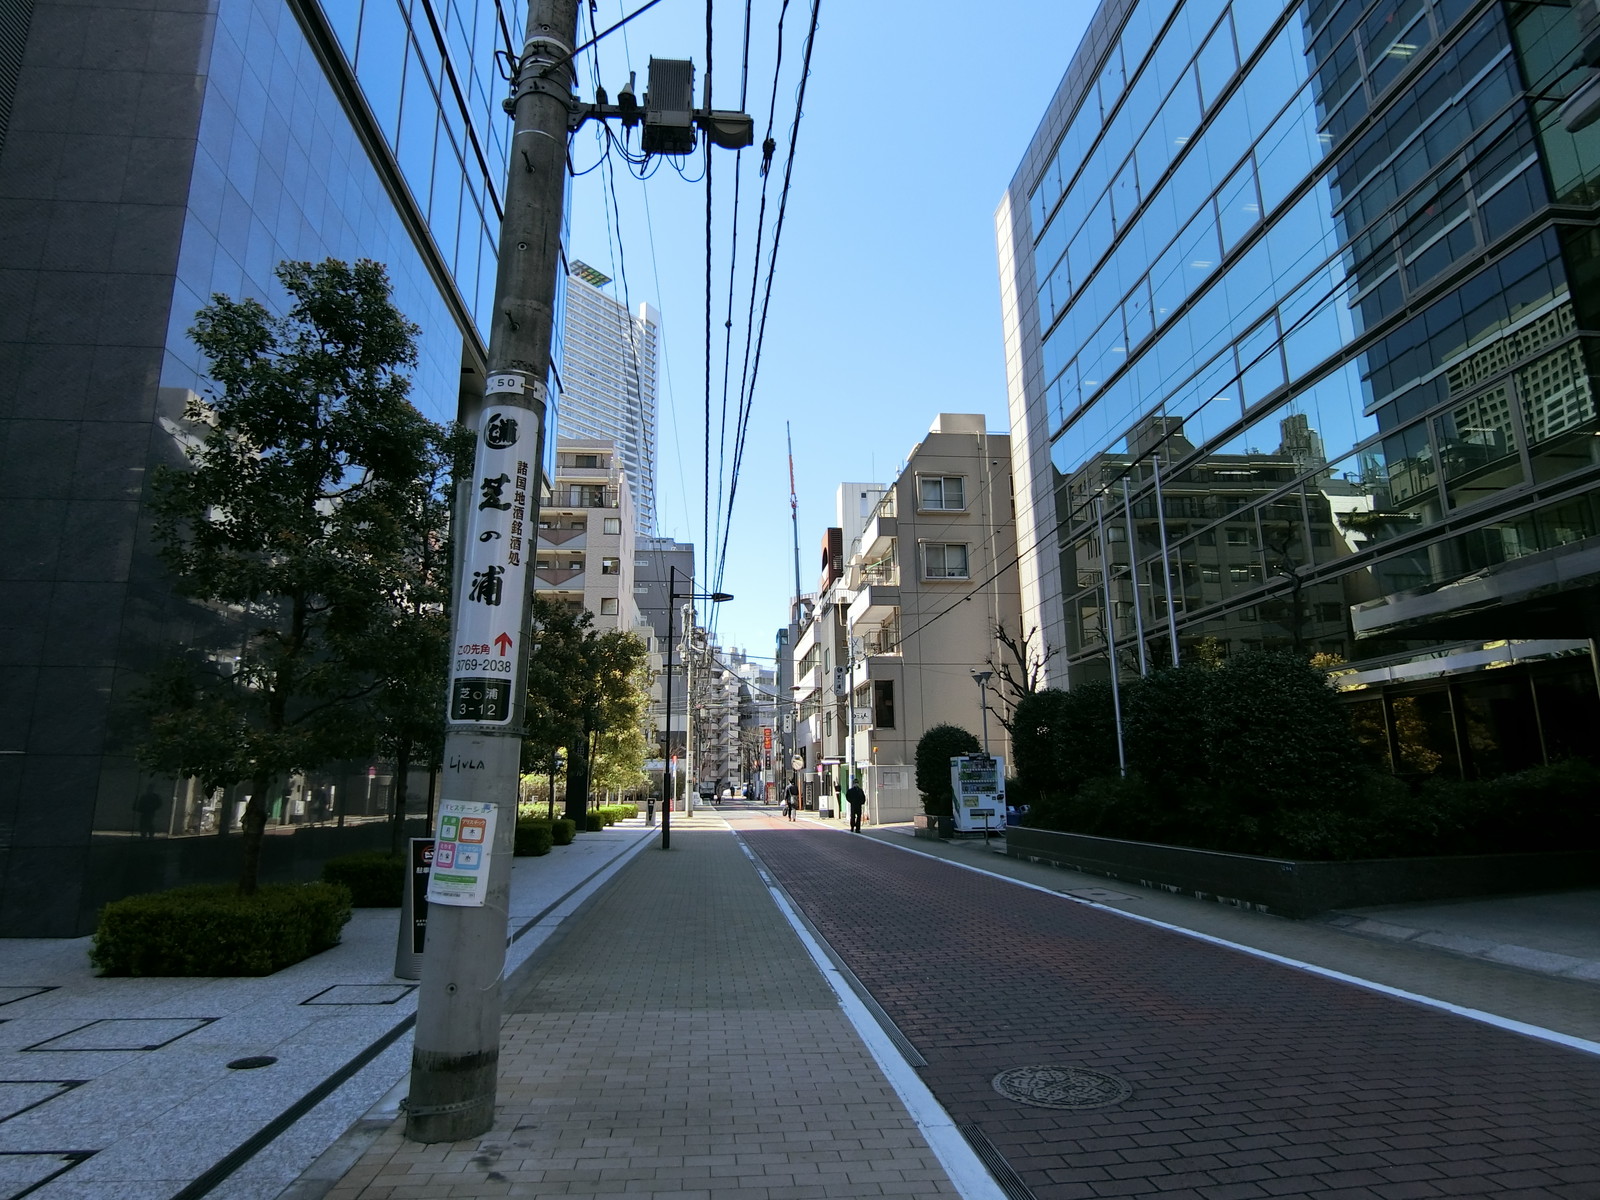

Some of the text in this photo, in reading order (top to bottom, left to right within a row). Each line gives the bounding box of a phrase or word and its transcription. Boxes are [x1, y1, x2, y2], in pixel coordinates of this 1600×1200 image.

[497, 378, 515, 387] 50
[508, 460, 528, 566] 諸国地酒銘酒処
[469, 473, 512, 606] 芝の浦
[457, 644, 490, 655] この先角
[457, 659, 511, 672] 3769-2038
[459, 704, 496, 715] 3-12
